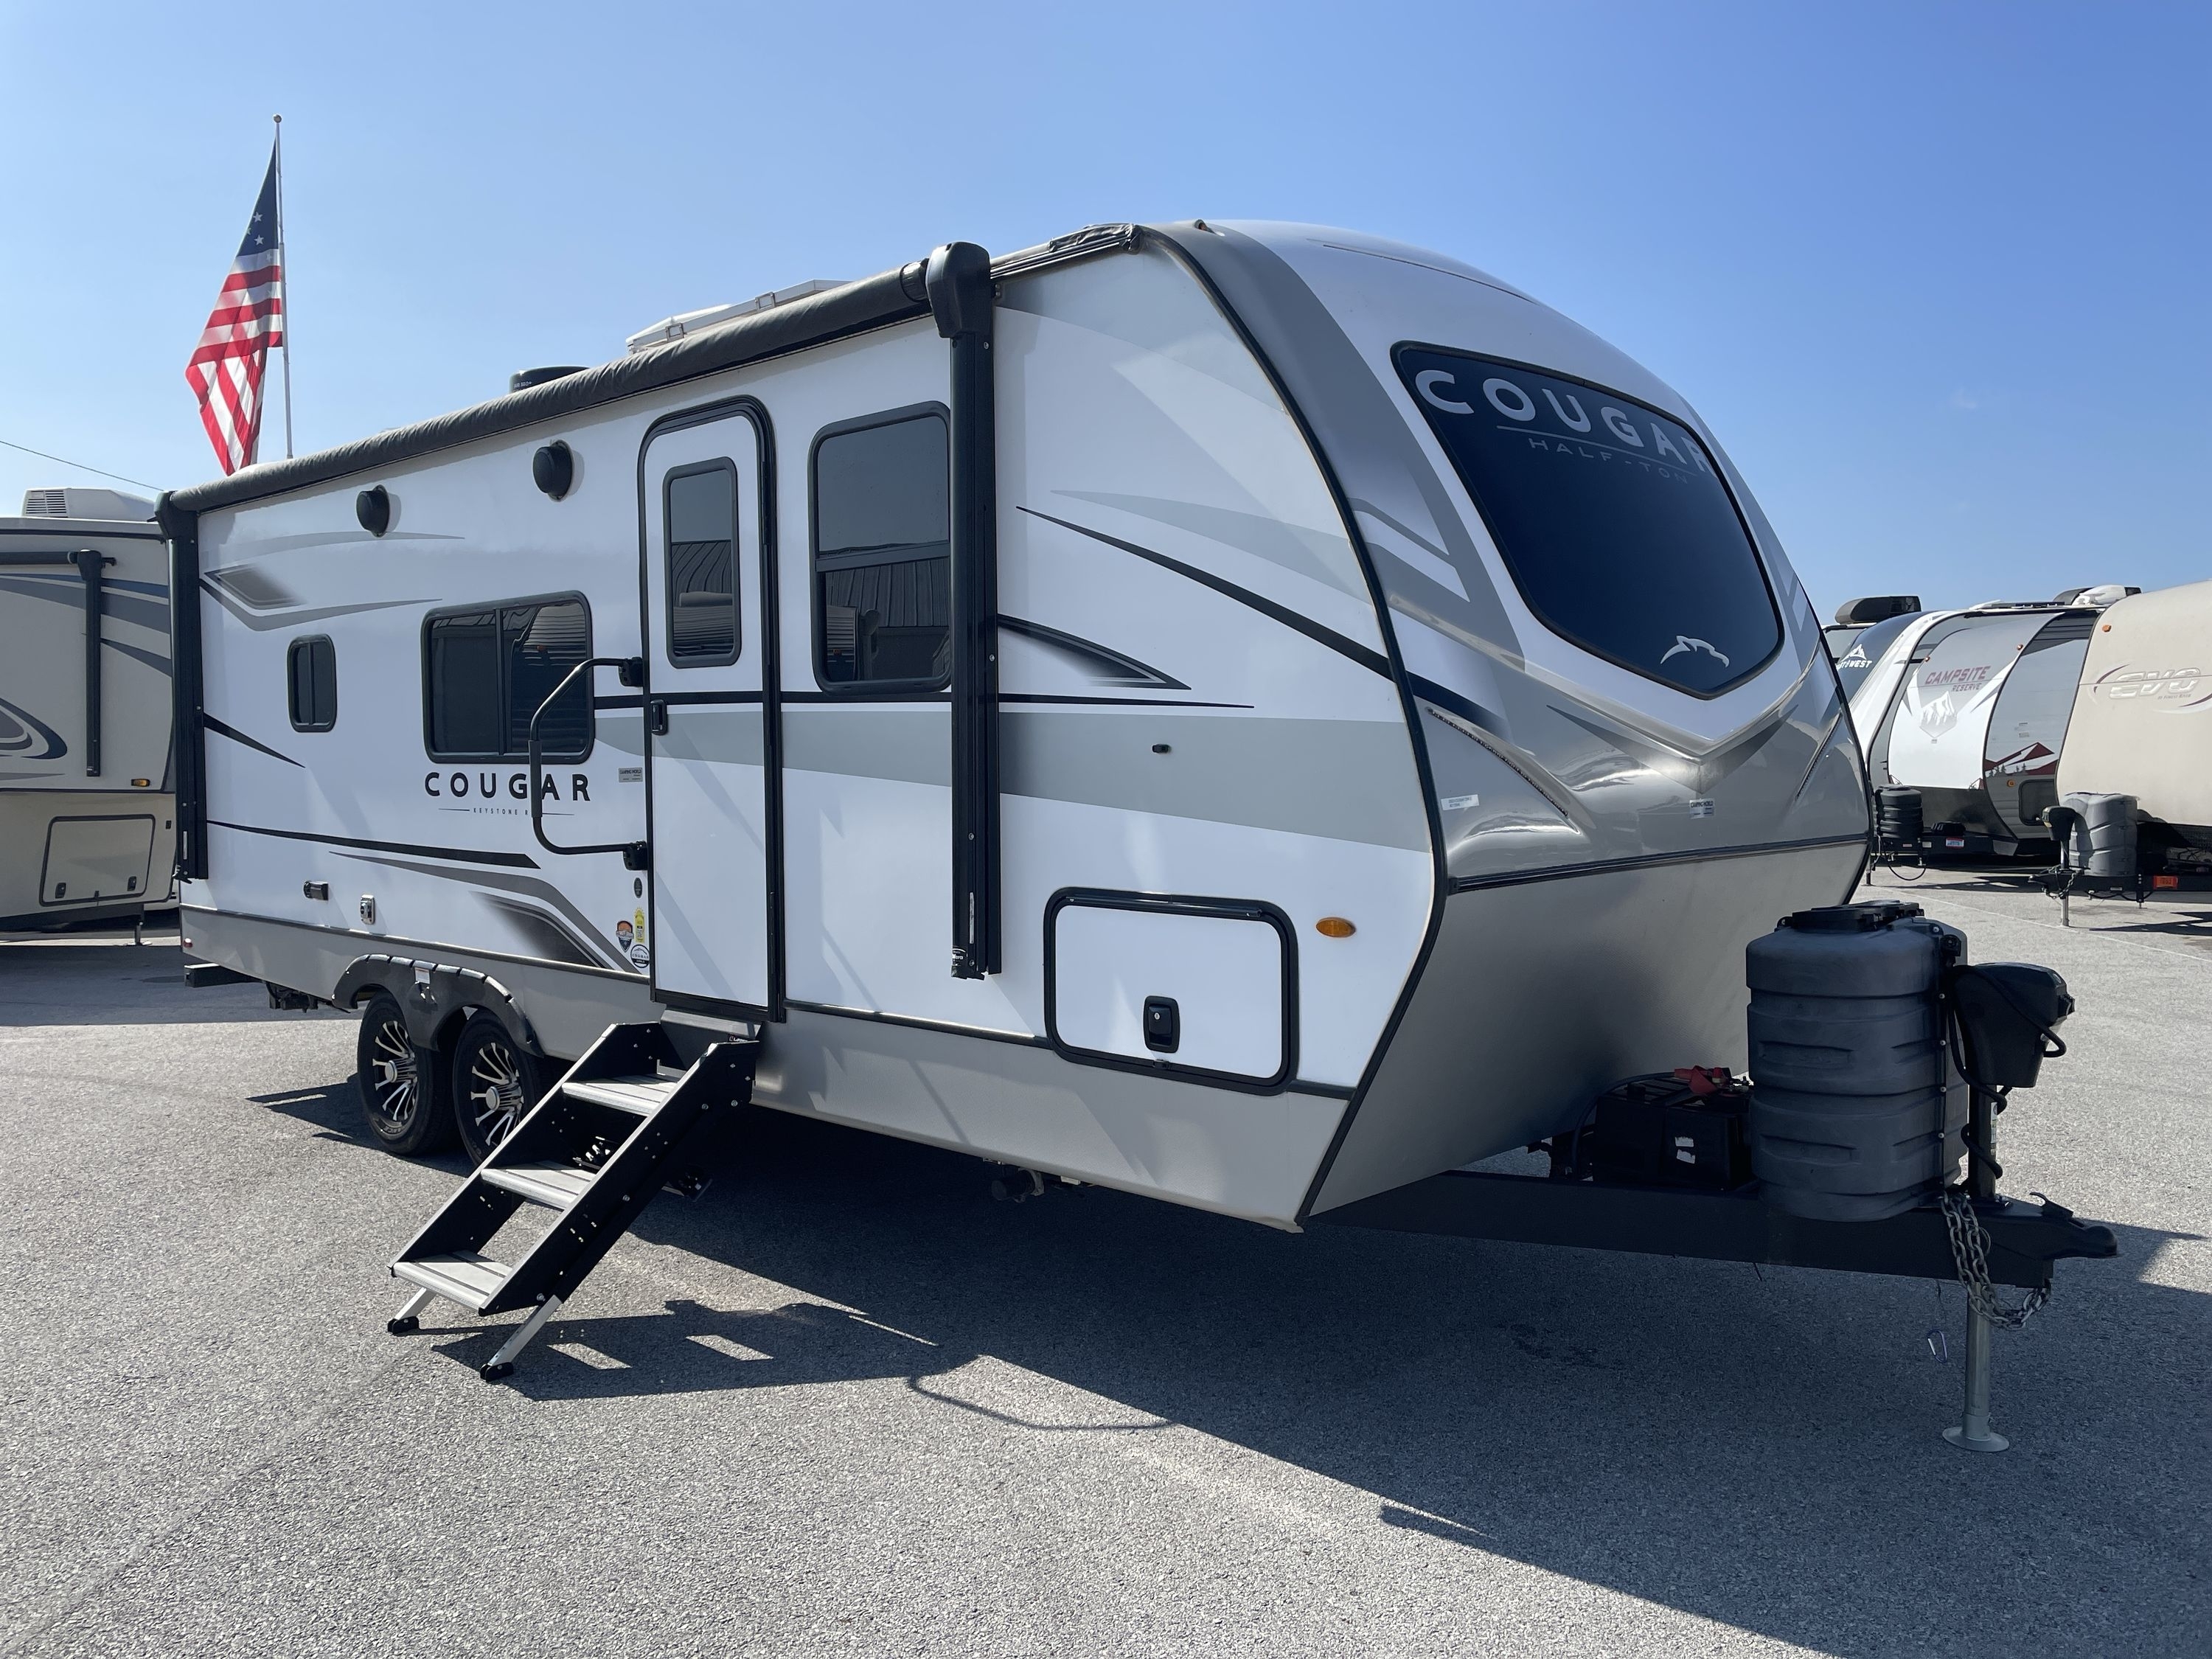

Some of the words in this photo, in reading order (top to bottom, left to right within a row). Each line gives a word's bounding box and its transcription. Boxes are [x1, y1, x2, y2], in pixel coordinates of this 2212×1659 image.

[1414, 369, 1717, 478] COUGAR
[1848, 659, 1873, 669] WEST
[1924, 665, 1992, 685] CAMPSITE
[1951, 683, 1982, 692] RESERVE
[425, 771, 591, 801] COUGAR
[473, 807, 518, 815] KEYSTONE
